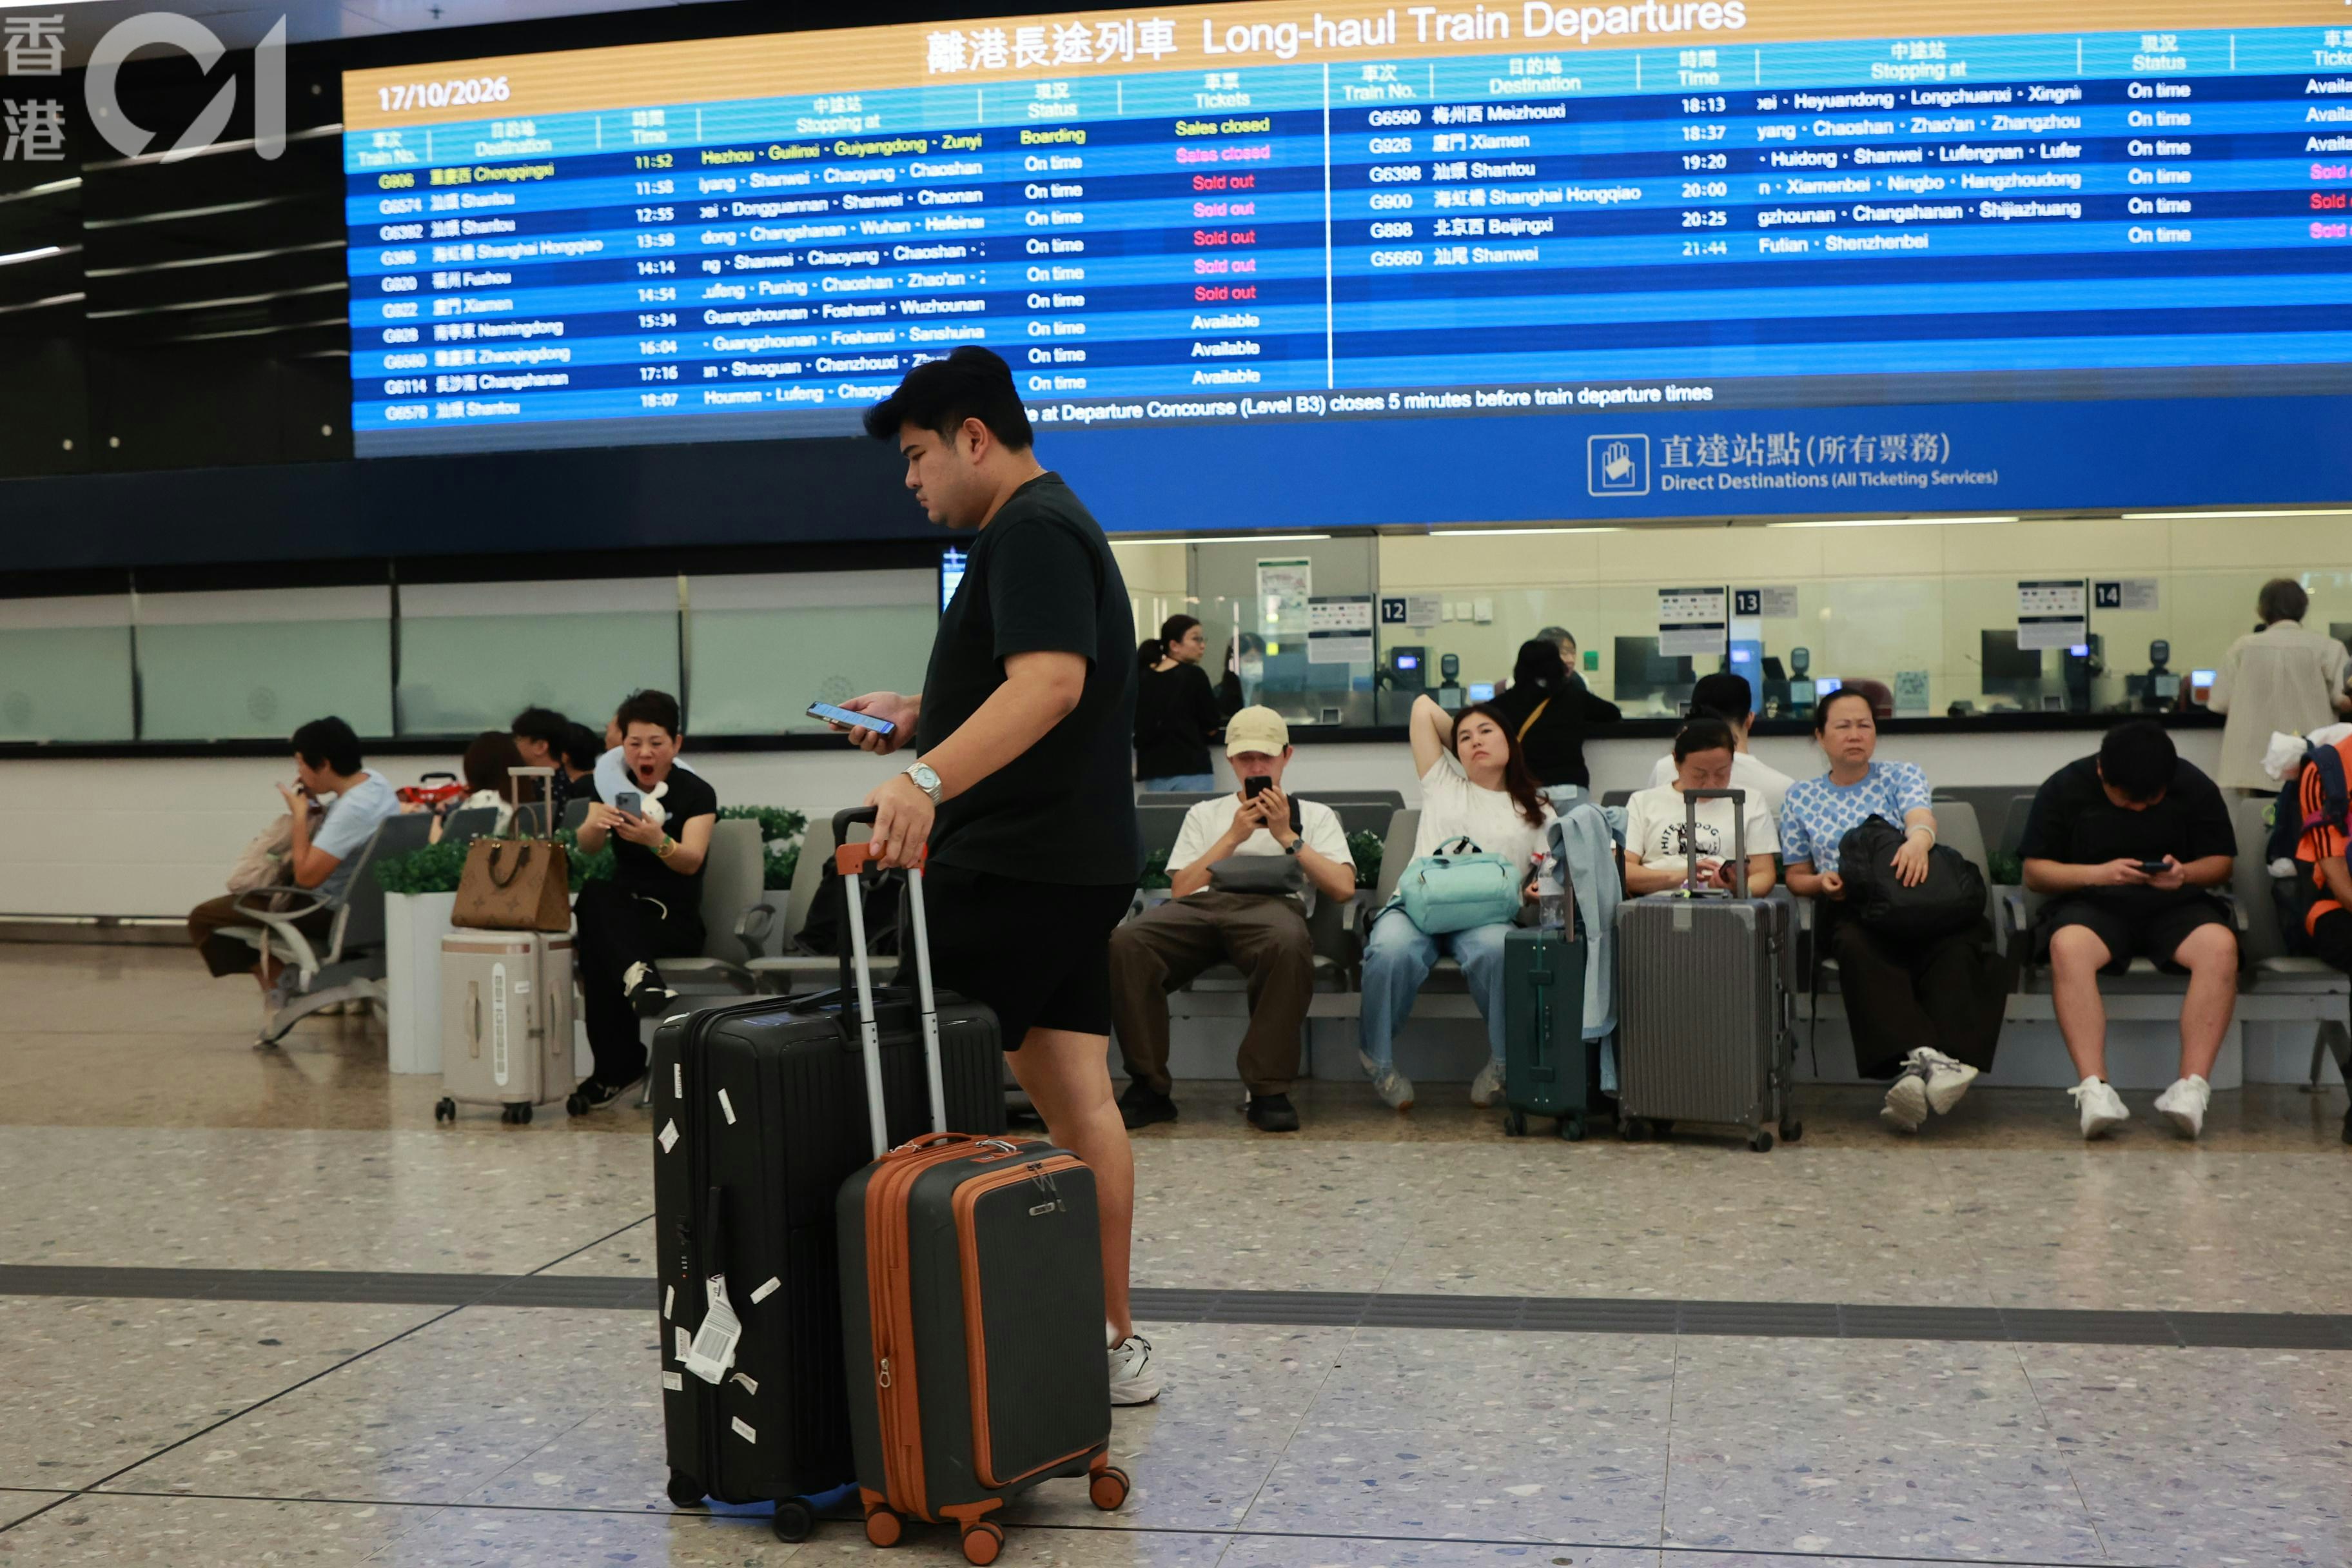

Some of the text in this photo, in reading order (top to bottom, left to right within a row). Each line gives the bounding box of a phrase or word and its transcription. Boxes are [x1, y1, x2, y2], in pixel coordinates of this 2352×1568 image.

[1202, 0, 1747, 59] Long-haul Train Departures
[926, 17, 1179, 74] 離港長途列車
[1679, 49, 1717, 68] 時間
[2133, 55, 2186, 71] Status
[1678, 70, 1720, 86] Time
[1871, 61, 1966, 81] Stopping at
[378, 75, 511, 112] 17/10/2026
[1343, 83, 1416, 101] Train No.
[1489, 76, 1582, 95] Destination
[2128, 82, 2191, 99] On time
[1195, 92, 1251, 109] Tickets
[1681, 96, 1726, 113] 18:13
[1794, 89, 2012, 112] Heyuandong Longchuanxi
[1027, 103, 1078, 119] Status
[1369, 109, 1422, 126] G6590
[1487, 104, 1566, 121] Meizhouxi
[2128, 110, 2191, 127] On time
[1175, 117, 1270, 136] Sales closed
[1682, 124, 1727, 141] 18:37
[1813, 113, 2081, 136] Chaoshan Zhao'an Zhangzhou
[1021, 128, 1086, 145] Boarding
[1470, 134, 1530, 150] Xiamen
[1175, 144, 1271, 164] Sales closed
[1369, 137, 1412, 154] G926
[2128, 139, 2191, 156] On time
[636, 153, 674, 168] 11:52
[1024, 155, 1083, 172] On time
[1682, 153, 1727, 170] 19:20
[1771, 144, 2023, 168] Huidong Shanwei Lufengnan
[1369, 166, 1422, 182] G6398
[1471, 162, 1536, 178] Shantou
[2128, 168, 2191, 184] On time
[2310, 162, 2347, 180] Sold
[636, 179, 674, 195] 11:58
[1193, 174, 1255, 191] Sold out
[1681, 181, 1727, 198] 20:00
[1787, 172, 2082, 194] Xiamenbei Ningbo Hangzhoudong
[1024, 184, 1083, 199] On time
[1489, 189, 1563, 207] Shanghai
[1566, 186, 1642, 204] Hongqiao
[1193, 202, 1255, 218] Sold out
[1369, 193, 1413, 210] G900
[2128, 197, 2191, 214] On time
[2310, 193, 2346, 210] Sold
[636, 207, 674, 222] 12:55
[1025, 210, 1084, 226] On time
[1682, 210, 1727, 227] 20:25
[1853, 201, 2081, 223] Changshanan Shijiazhuang
[1370, 222, 1413, 239] G898
[1434, 217, 1553, 236] 北京西 Beijingxi
[2128, 226, 2191, 243] On time
[2309, 222, 2347, 239] Sold
[637, 233, 675, 248] 13:58
[1026, 238, 1084, 254] On time
[1193, 230, 1256, 246] Sold out
[1759, 233, 1928, 253] Futian Shenzhenbei
[1472, 246, 1539, 263] Shanwei
[1682, 241, 1727, 256] 21:44
[1193, 258, 1257, 275] Sold out
[1371, 250, 1423, 267] G5660
[638, 260, 676, 275] 14:14
[1026, 266, 1084, 282] On time
[638, 287, 676, 302] 14:54
[759, 280, 808, 296] Puning
[1195, 286, 1257, 301] Sold out
[1027, 293, 1085, 308] On time
[640, 313, 677, 328] 15:34
[1028, 321, 1086, 336] On time
[1191, 313, 1260, 329] Available
[640, 340, 678, 355] 16:04
[1028, 348, 1086, 363] On time
[1191, 340, 1260, 357] Available
[640, 366, 678, 380] 17:16
[1192, 369, 1261, 385] Available
[1028, 376, 1086, 391] On time
[1041, 406, 1059, 422] at
[1061, 404, 1144, 424] Departure
[1146, 401, 1237, 418] Concourse
[1240, 396, 1292, 418] (Level
[1296, 395, 1326, 416] B3)
[1329, 395, 1385, 411] closes
[1388, 393, 1401, 409] 5
[1404, 391, 1472, 409] minutes
[1475, 389, 1531, 407] before
[1534, 387, 1573, 406] train
[1577, 386, 1662, 408] departure
[1665, 384, 1714, 402] times
[1661, 431, 1950, 467] 直達站點(所有票務)
[1661, 471, 1997, 491] Direct Destinations (All Ticketing Services)
[1738, 594, 1758, 611] 13
[2099, 587, 2118, 603] 14
[1384, 603, 1404, 619] 12
